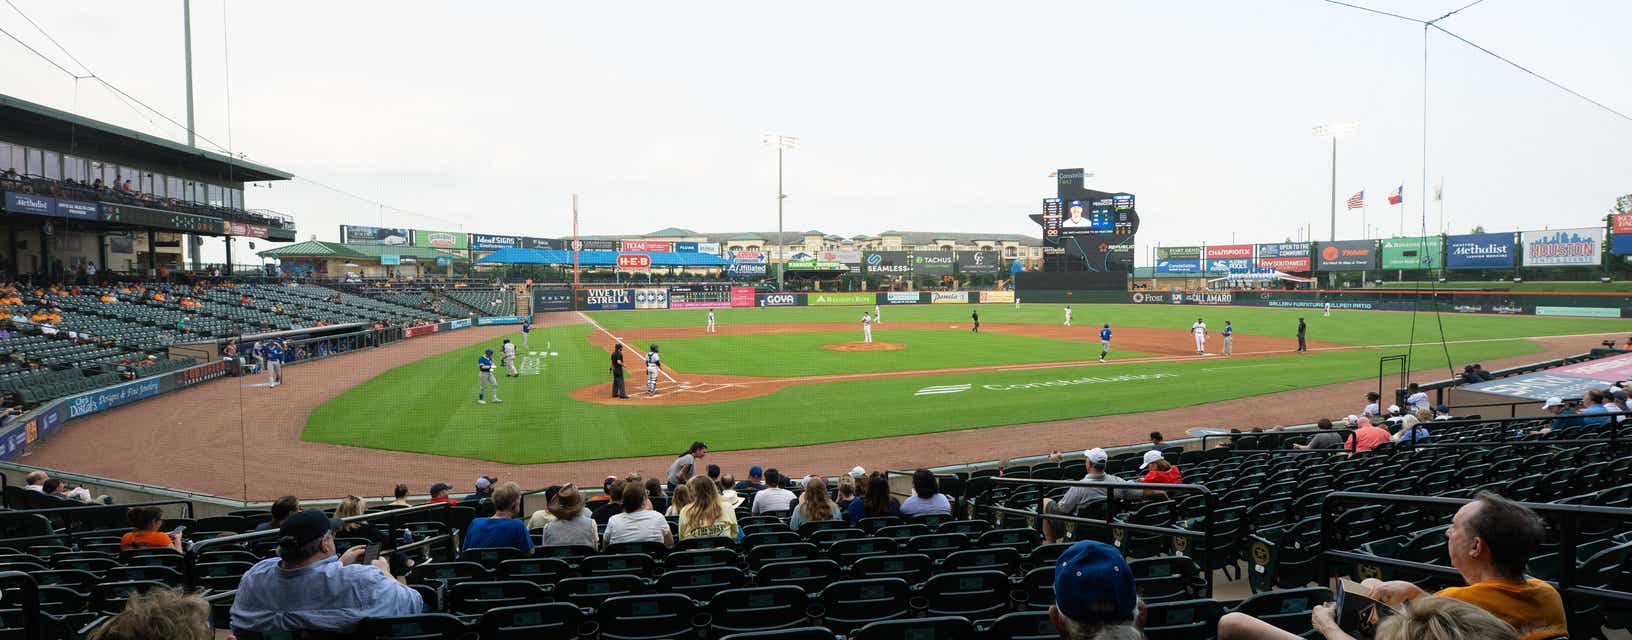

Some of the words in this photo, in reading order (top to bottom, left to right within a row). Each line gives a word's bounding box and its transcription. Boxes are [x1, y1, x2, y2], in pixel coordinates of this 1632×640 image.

[1453, 244, 1508, 255] Methodist
[1530, 242, 1594, 256] HOUSTON
[587, 296, 629, 304] ESTRELLA
[767, 295, 794, 304] GOYA
